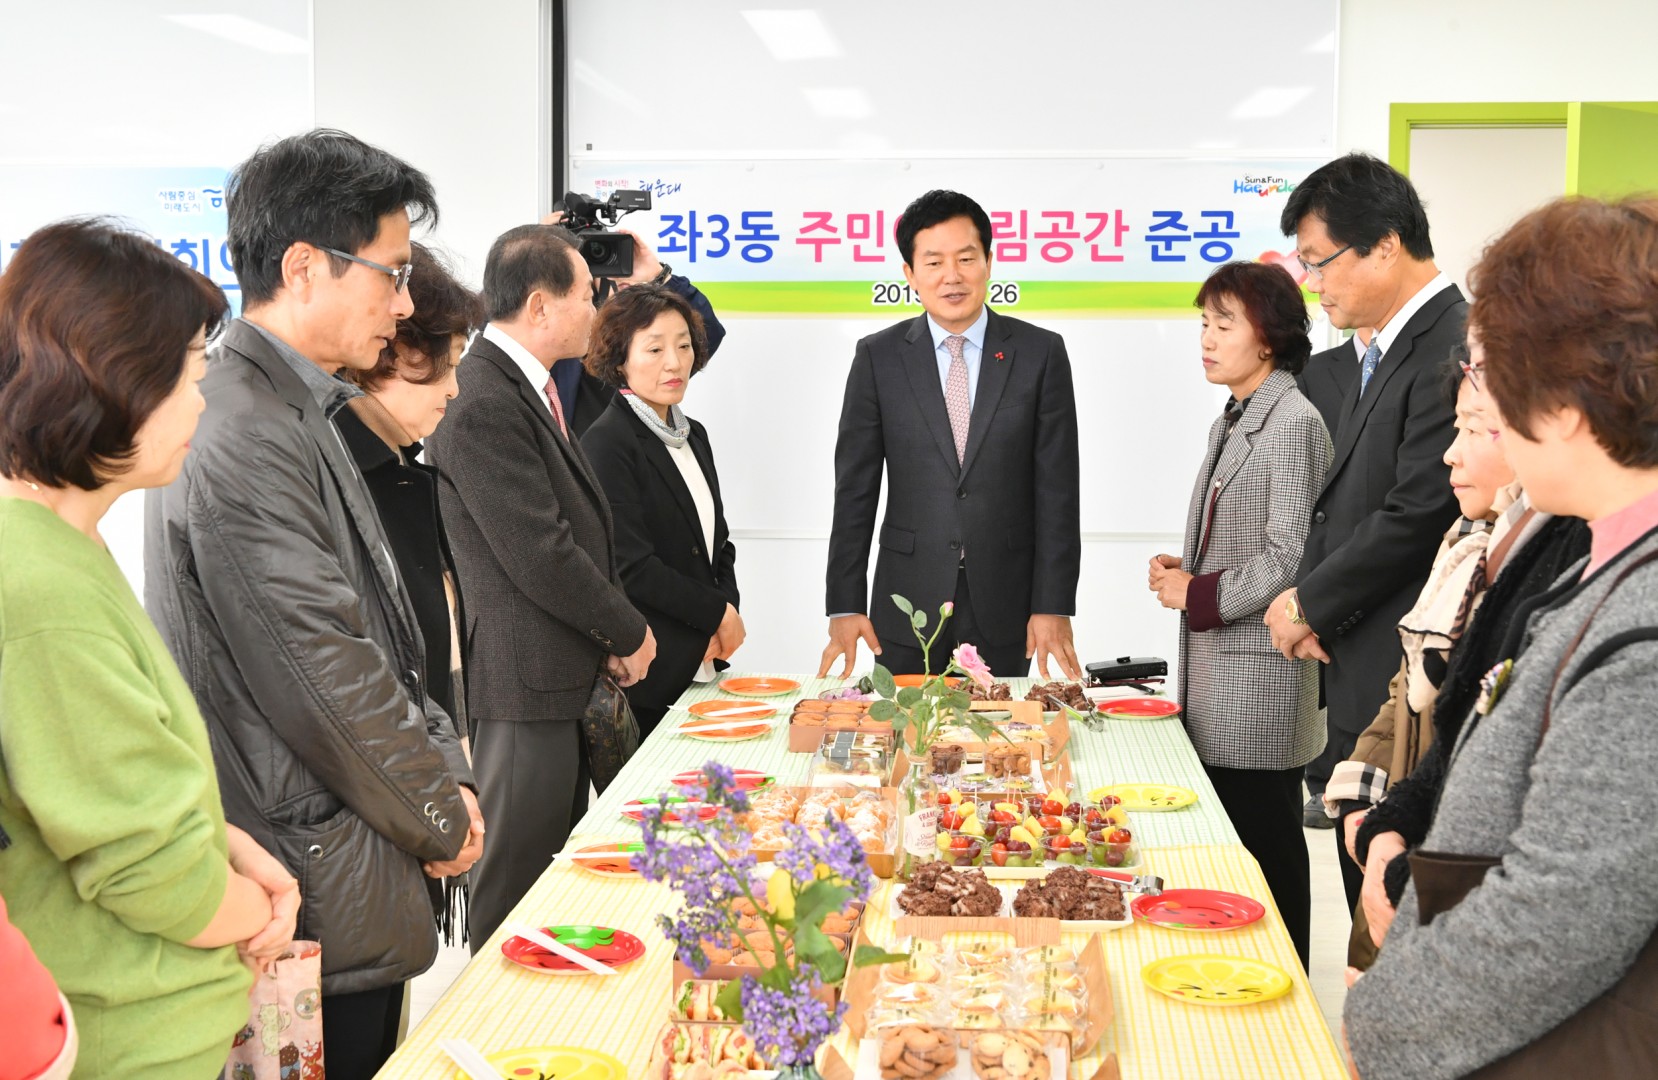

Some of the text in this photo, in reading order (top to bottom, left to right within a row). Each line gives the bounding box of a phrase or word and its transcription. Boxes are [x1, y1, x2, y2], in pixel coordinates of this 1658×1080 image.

[1233, 179, 1297, 197] Haeunda
[1244, 175, 1284, 184] Sun&Fun
[657, 210, 1240, 263] 좌3동 주민림공간 준공
[990, 284, 1018, 303] 26
